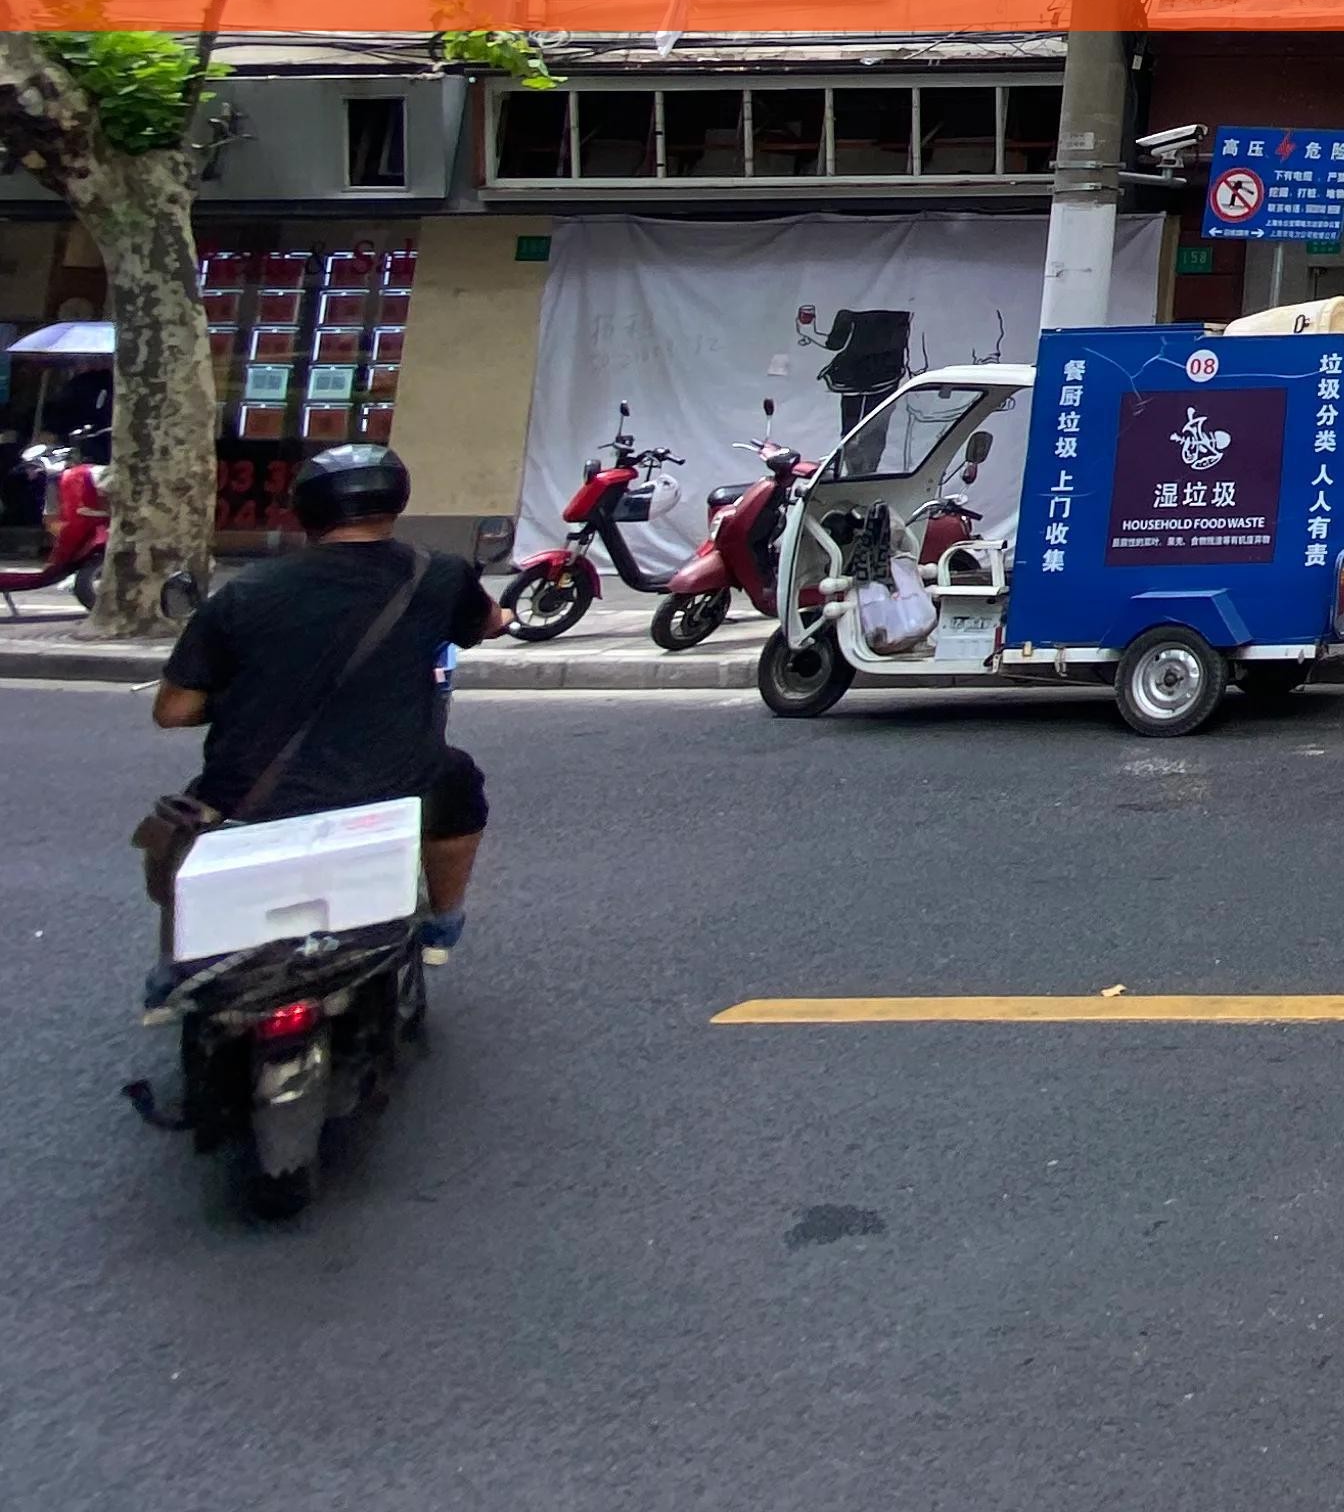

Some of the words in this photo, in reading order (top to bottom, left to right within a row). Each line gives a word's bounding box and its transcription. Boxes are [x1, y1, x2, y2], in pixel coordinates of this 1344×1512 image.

[1222, 138, 1265, 157] 高压
[1182, 251, 1207, 264] 158
[1190, 358, 1215, 375] 08
[1054, 359, 1086, 458] 餐厨垃圾
[1314, 353, 1343, 452] 垃圾分类
[1153, 481, 1236, 508] 湿垃圾
[1042, 469, 1074, 572] 上门收集
[1122, 519, 1192, 531] HOUSEHOLD
[1194, 518, 1226, 529] FOOD
[1227, 517, 1265, 529] WASTE
[1304, 463, 1334, 567] 人人有责
